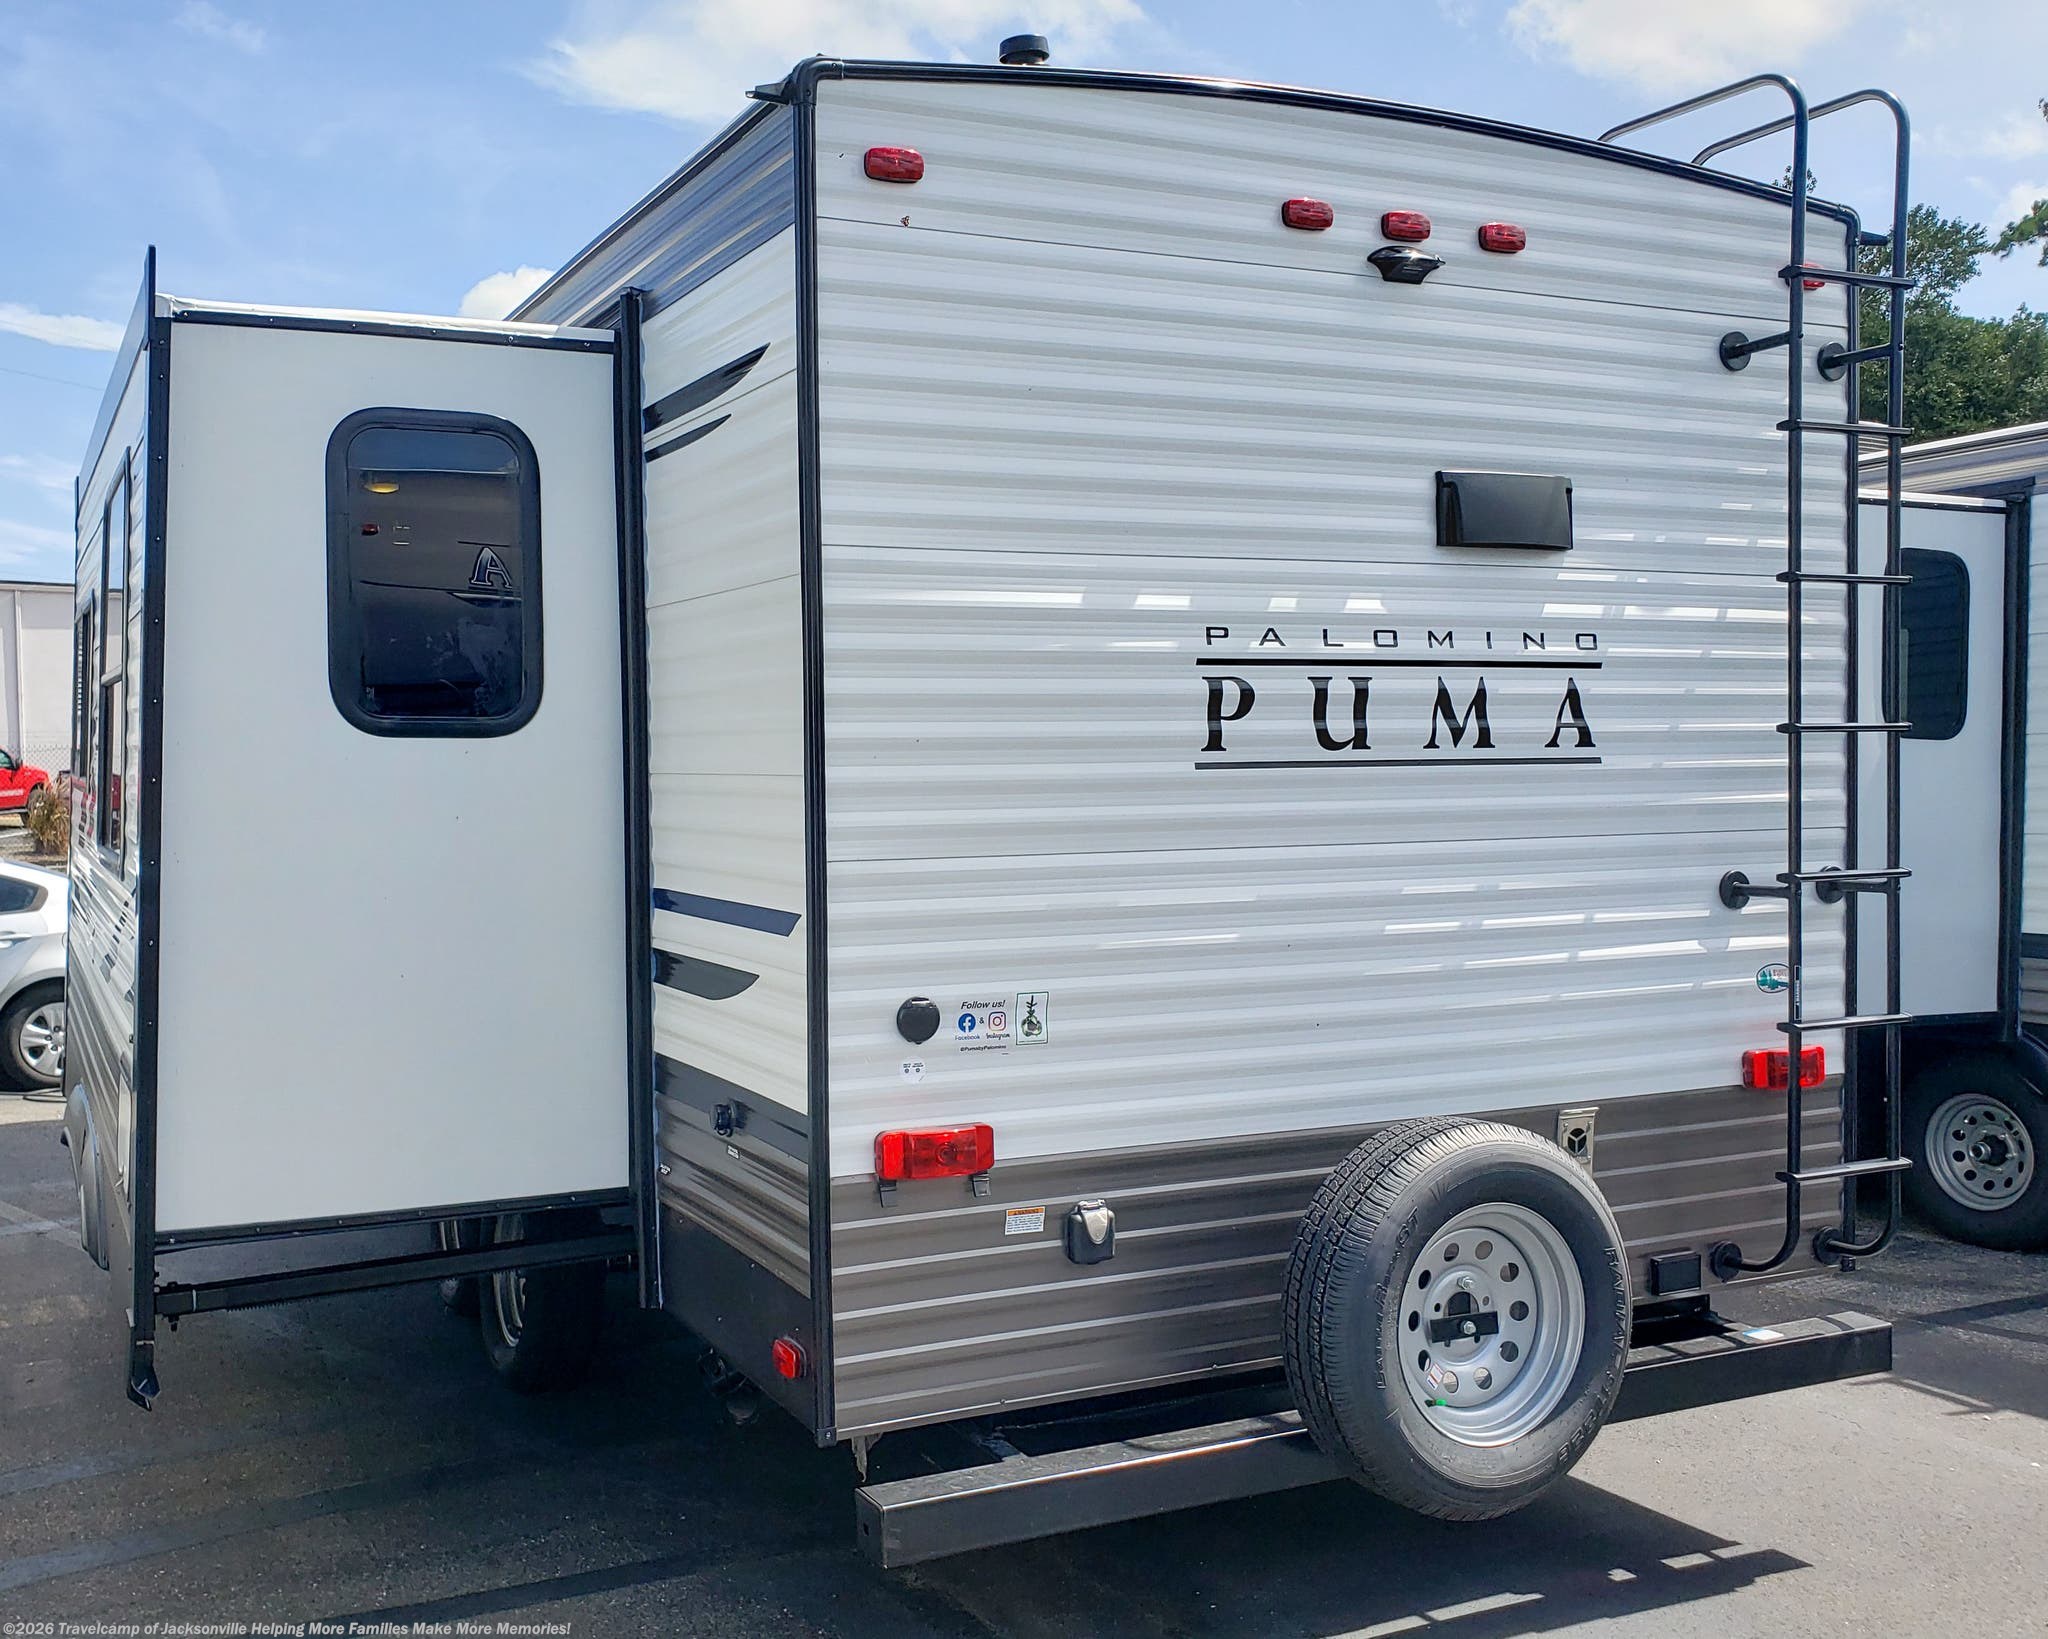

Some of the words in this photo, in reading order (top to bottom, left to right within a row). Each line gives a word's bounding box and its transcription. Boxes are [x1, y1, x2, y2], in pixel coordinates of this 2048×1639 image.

[1205, 626, 1598, 651] PALOMINO
[1200, 676, 1597, 752] PUMA
[961, 1000, 990, 1010] Follow
[992, 999, 1006, 1008] us!
